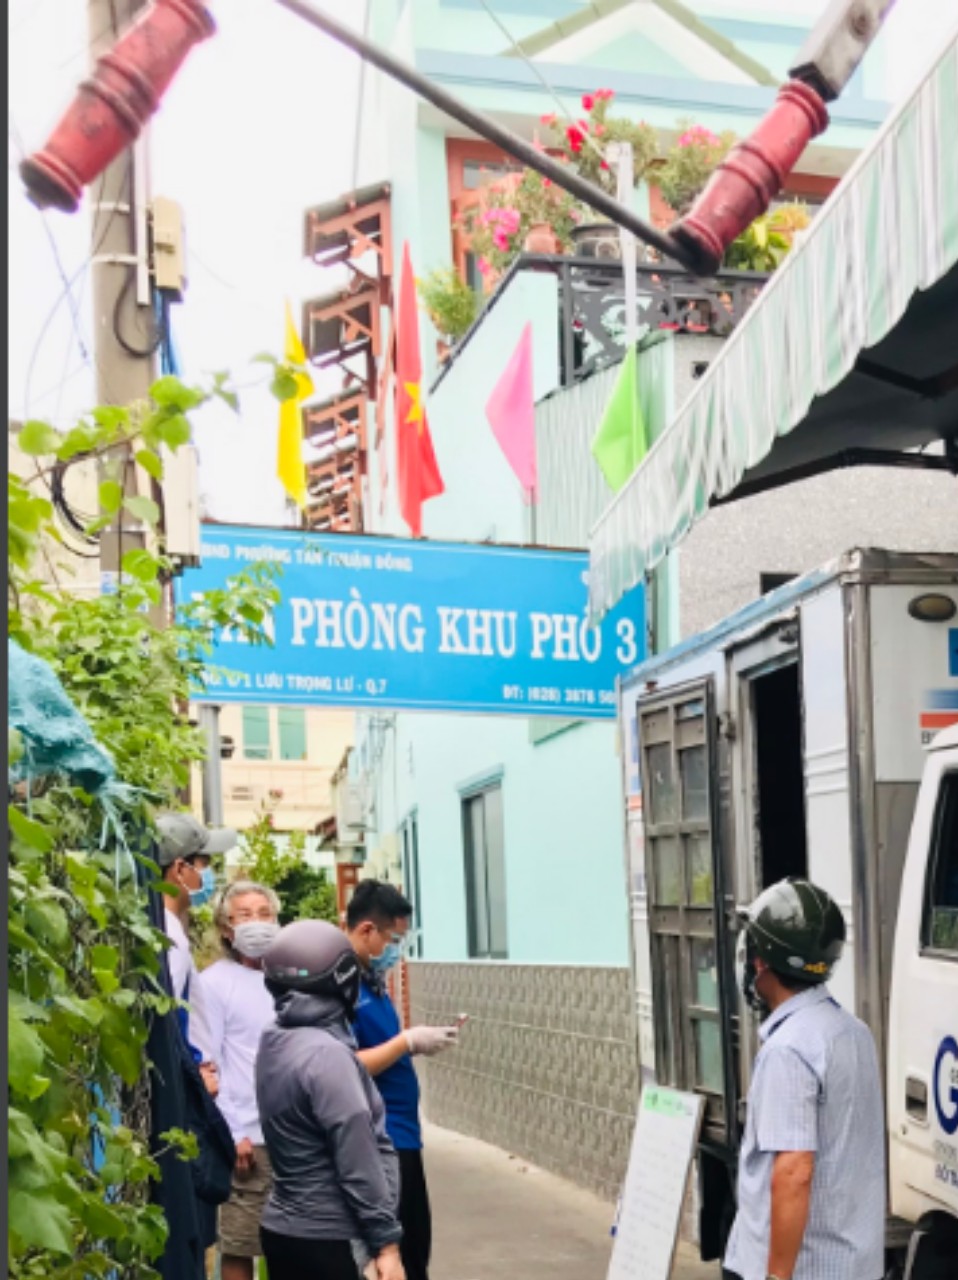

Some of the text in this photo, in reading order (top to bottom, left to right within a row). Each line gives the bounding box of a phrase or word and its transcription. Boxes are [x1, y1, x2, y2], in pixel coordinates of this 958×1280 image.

[202, 543, 230, 559] BND
[290, 586, 426, 653] PHÒNG
[437, 605, 518, 658] KHU
[616, 617, 637, 664] 3
